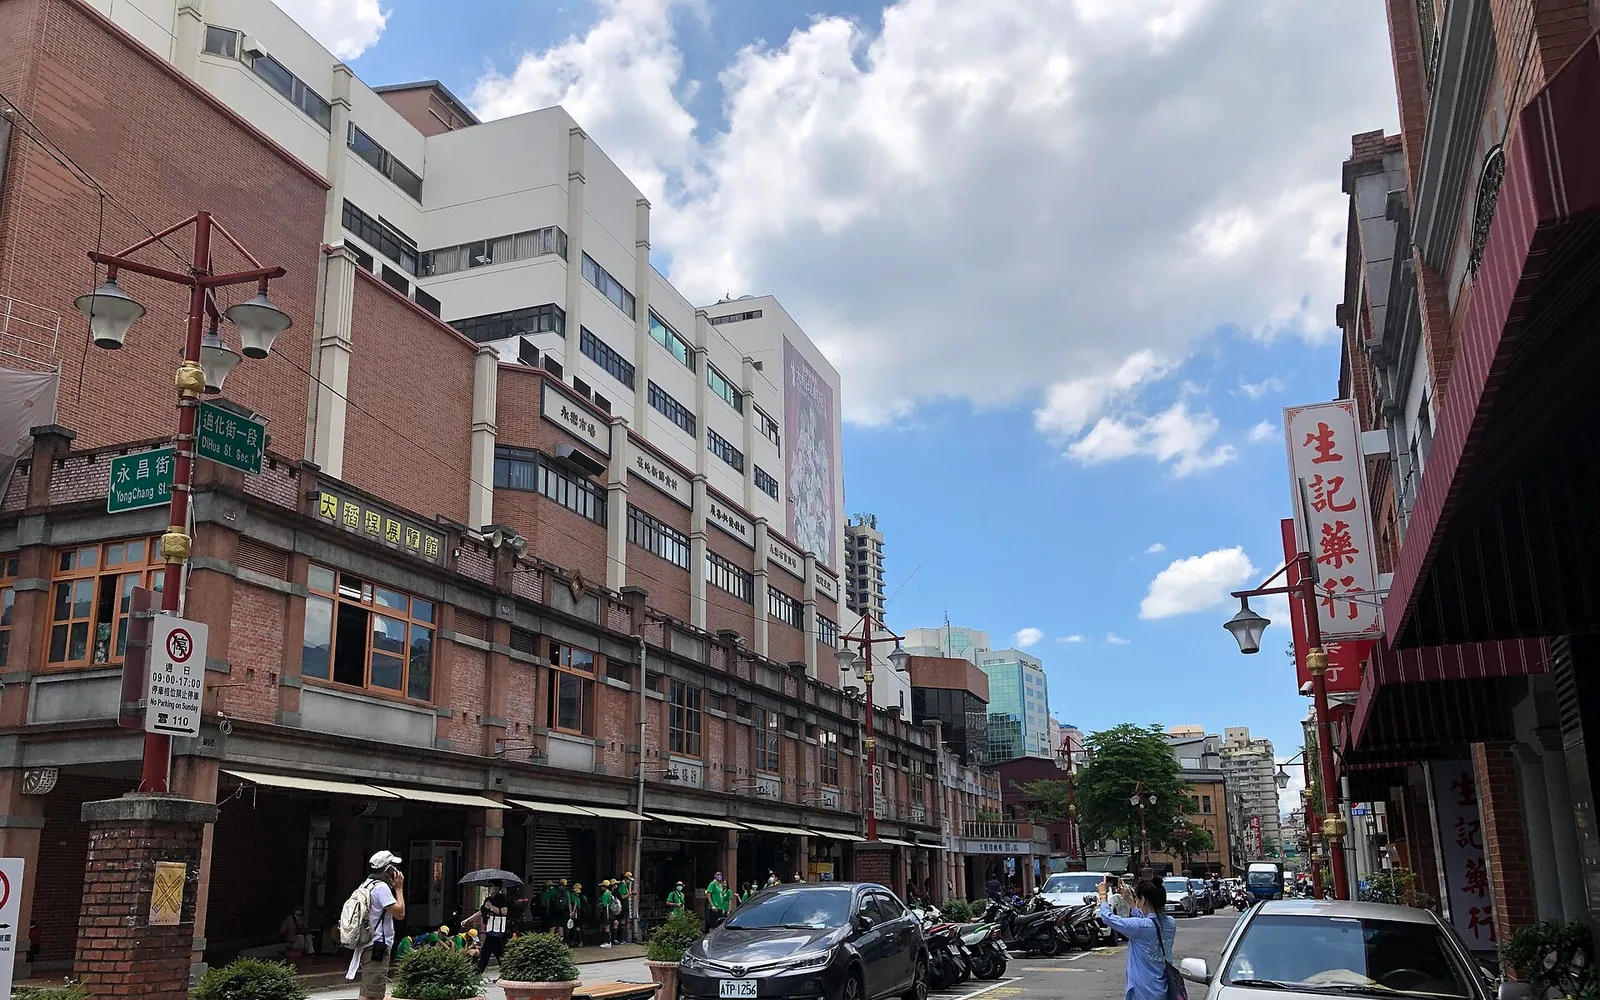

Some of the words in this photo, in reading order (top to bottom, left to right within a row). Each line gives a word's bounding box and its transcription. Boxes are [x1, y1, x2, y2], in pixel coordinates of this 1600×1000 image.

[202, 410, 258, 447] 迪化街一段
[202, 435, 221, 454] DiHua
[224, 444, 233, 458] St.
[236, 447, 250, 464] Sec.
[116, 455, 170, 484] 永昌街
[116, 486, 154, 504] YongChang
[158, 482, 168, 496] St.
[320, 494, 438, 557] 大稻埕展覽館
[1302, 421, 1366, 620] 生記藥行
[152, 672, 200, 689] 09:00-17:00
[151, 685, 200, 701] 停車格位禁止停車
[150, 697, 157, 706] No
[157, 698, 174, 710] Parking
[182, 702, 198, 714] Sunday
[172, 716, 189, 726] 110
[720, 984, 756, 995] ATP-1256
